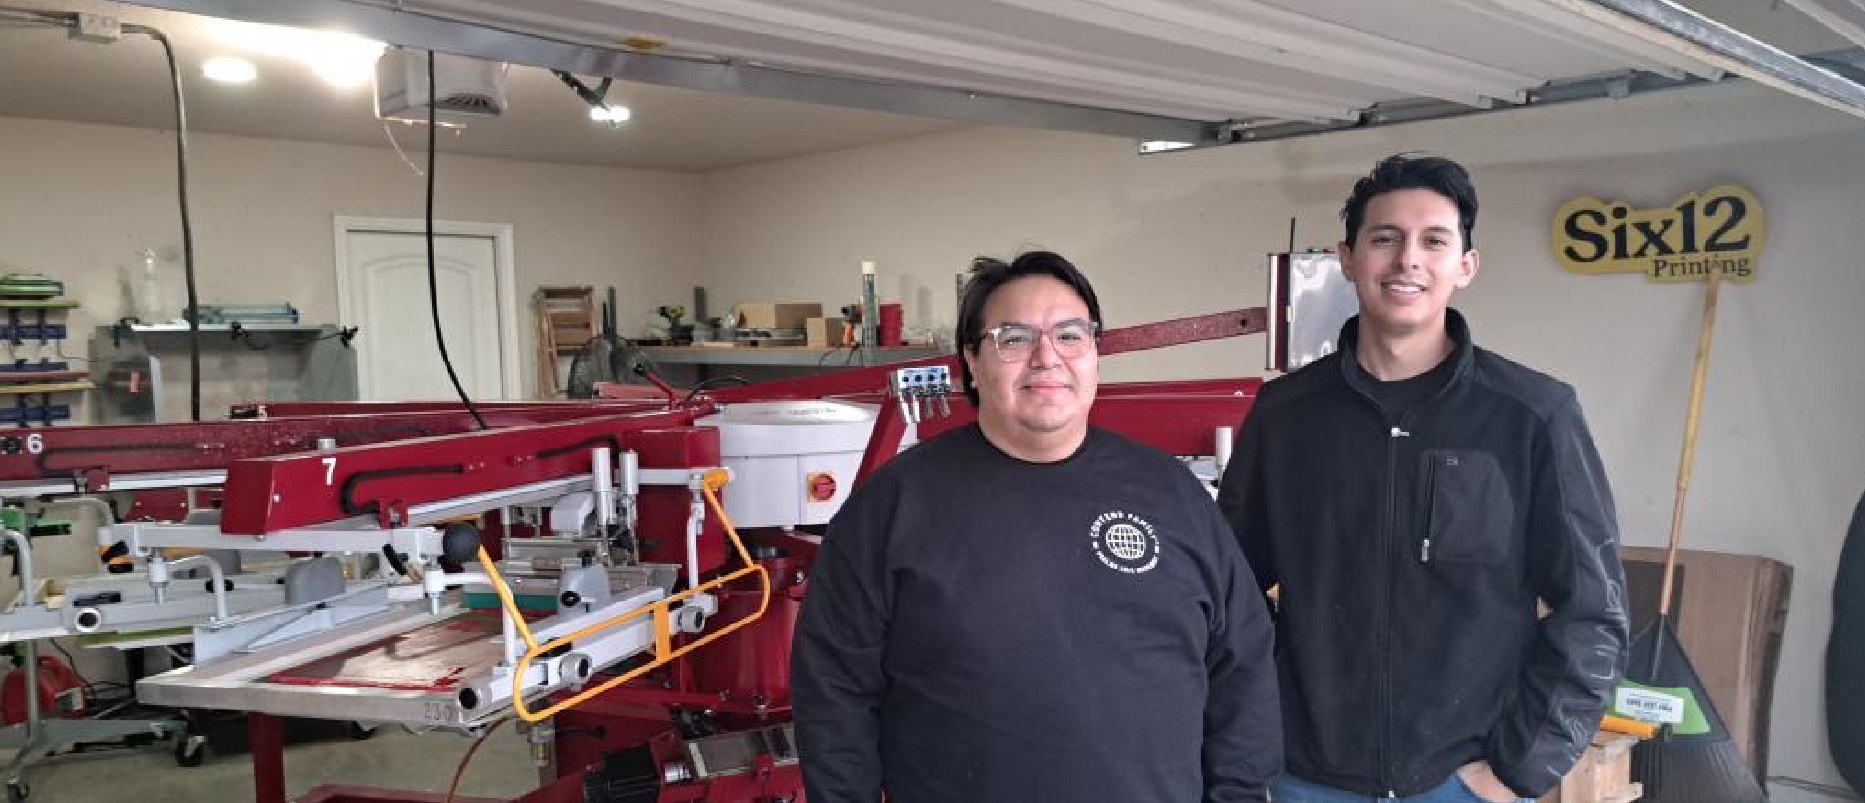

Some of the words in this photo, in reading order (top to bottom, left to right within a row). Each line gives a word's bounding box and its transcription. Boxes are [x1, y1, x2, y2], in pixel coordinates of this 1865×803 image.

[1563, 195, 1751, 263] Six12
[28, 433, 42, 454] 6
[322, 457, 337, 485] 7
